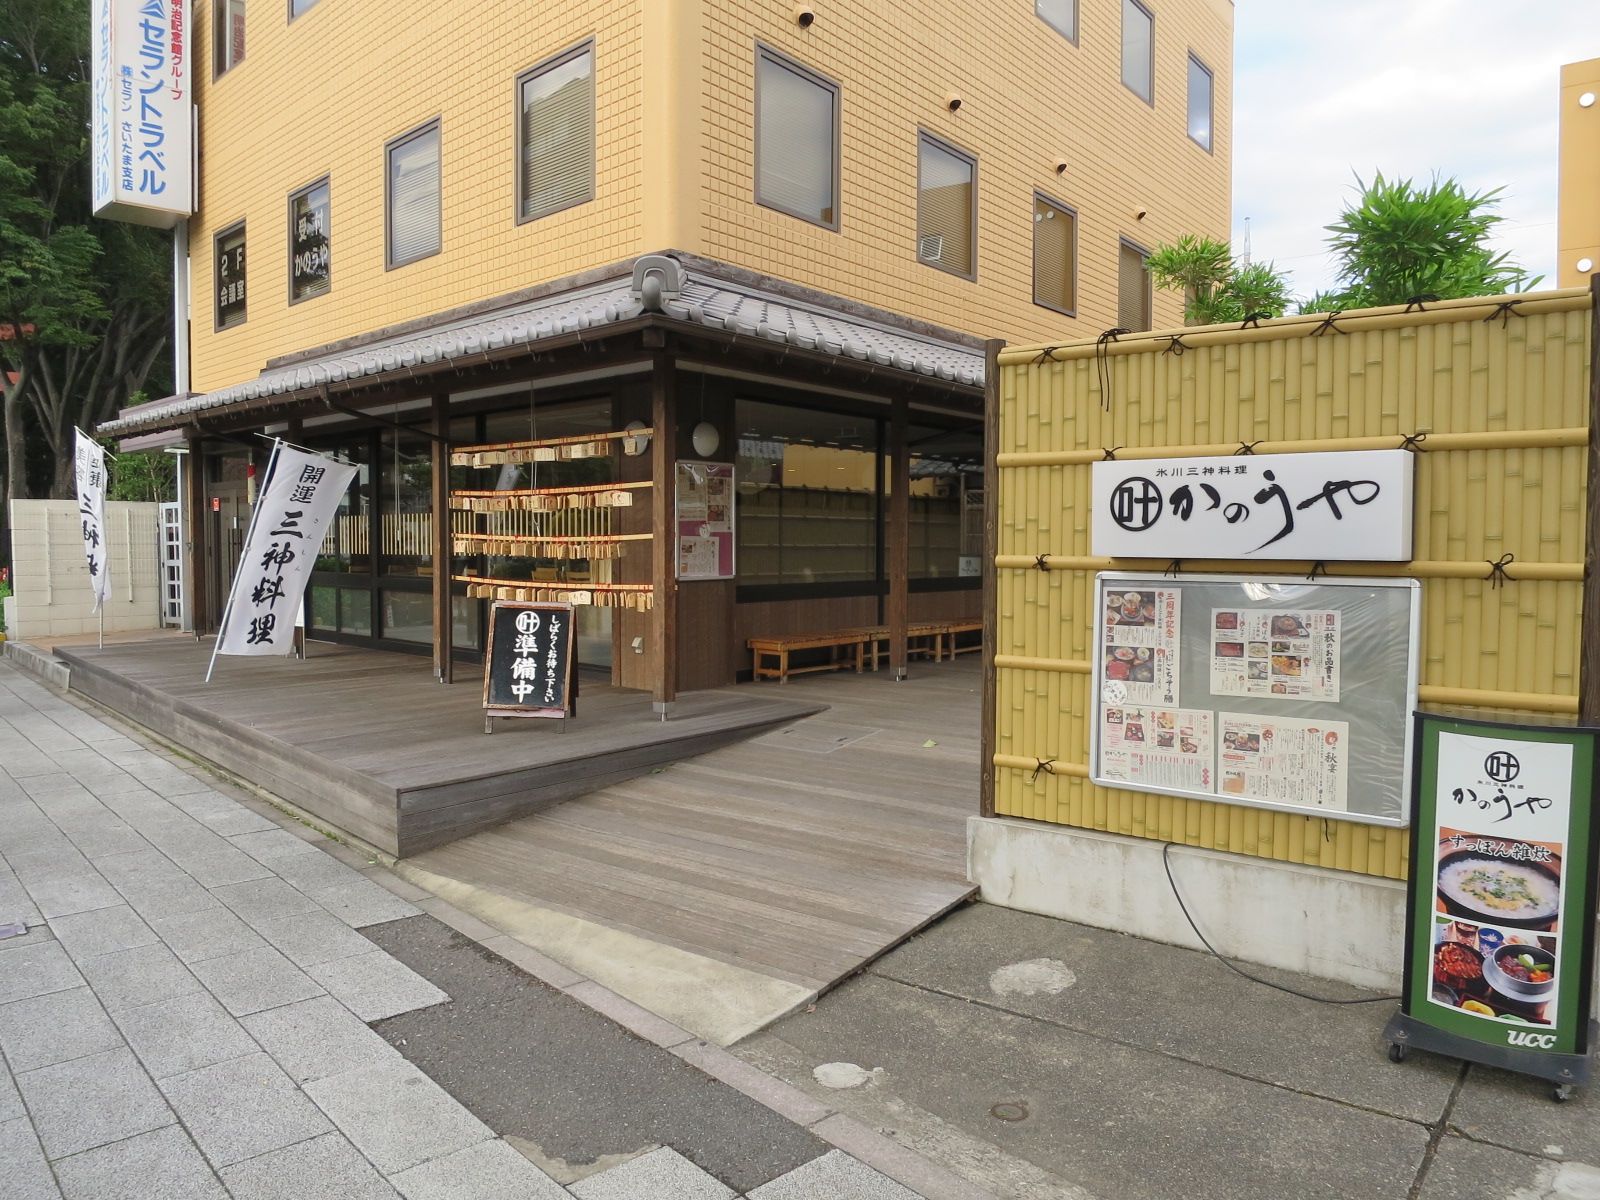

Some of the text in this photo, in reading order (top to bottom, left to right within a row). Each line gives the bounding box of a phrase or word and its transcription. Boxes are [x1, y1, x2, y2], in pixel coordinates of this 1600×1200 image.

[139, 18, 166, 195] セラントラベル
[121, 121, 133, 191] さいたま支店
[221, 280, 244, 307] 会議室
[289, 464, 325, 504] 開運
[1155, 465, 1248, 477] 氷川三神料理
[1169, 469, 1380, 555] かのうや
[247, 510, 304, 645] 三神料理
[1165, 592, 1175, 639] 三周年記念
[510, 634, 539, 704] 準備中
[544, 614, 561, 703] しばらくお待ち下さい
[1452, 788, 1553, 823] かのうや
[1449, 835, 1552, 862] すっぽん雑炊
